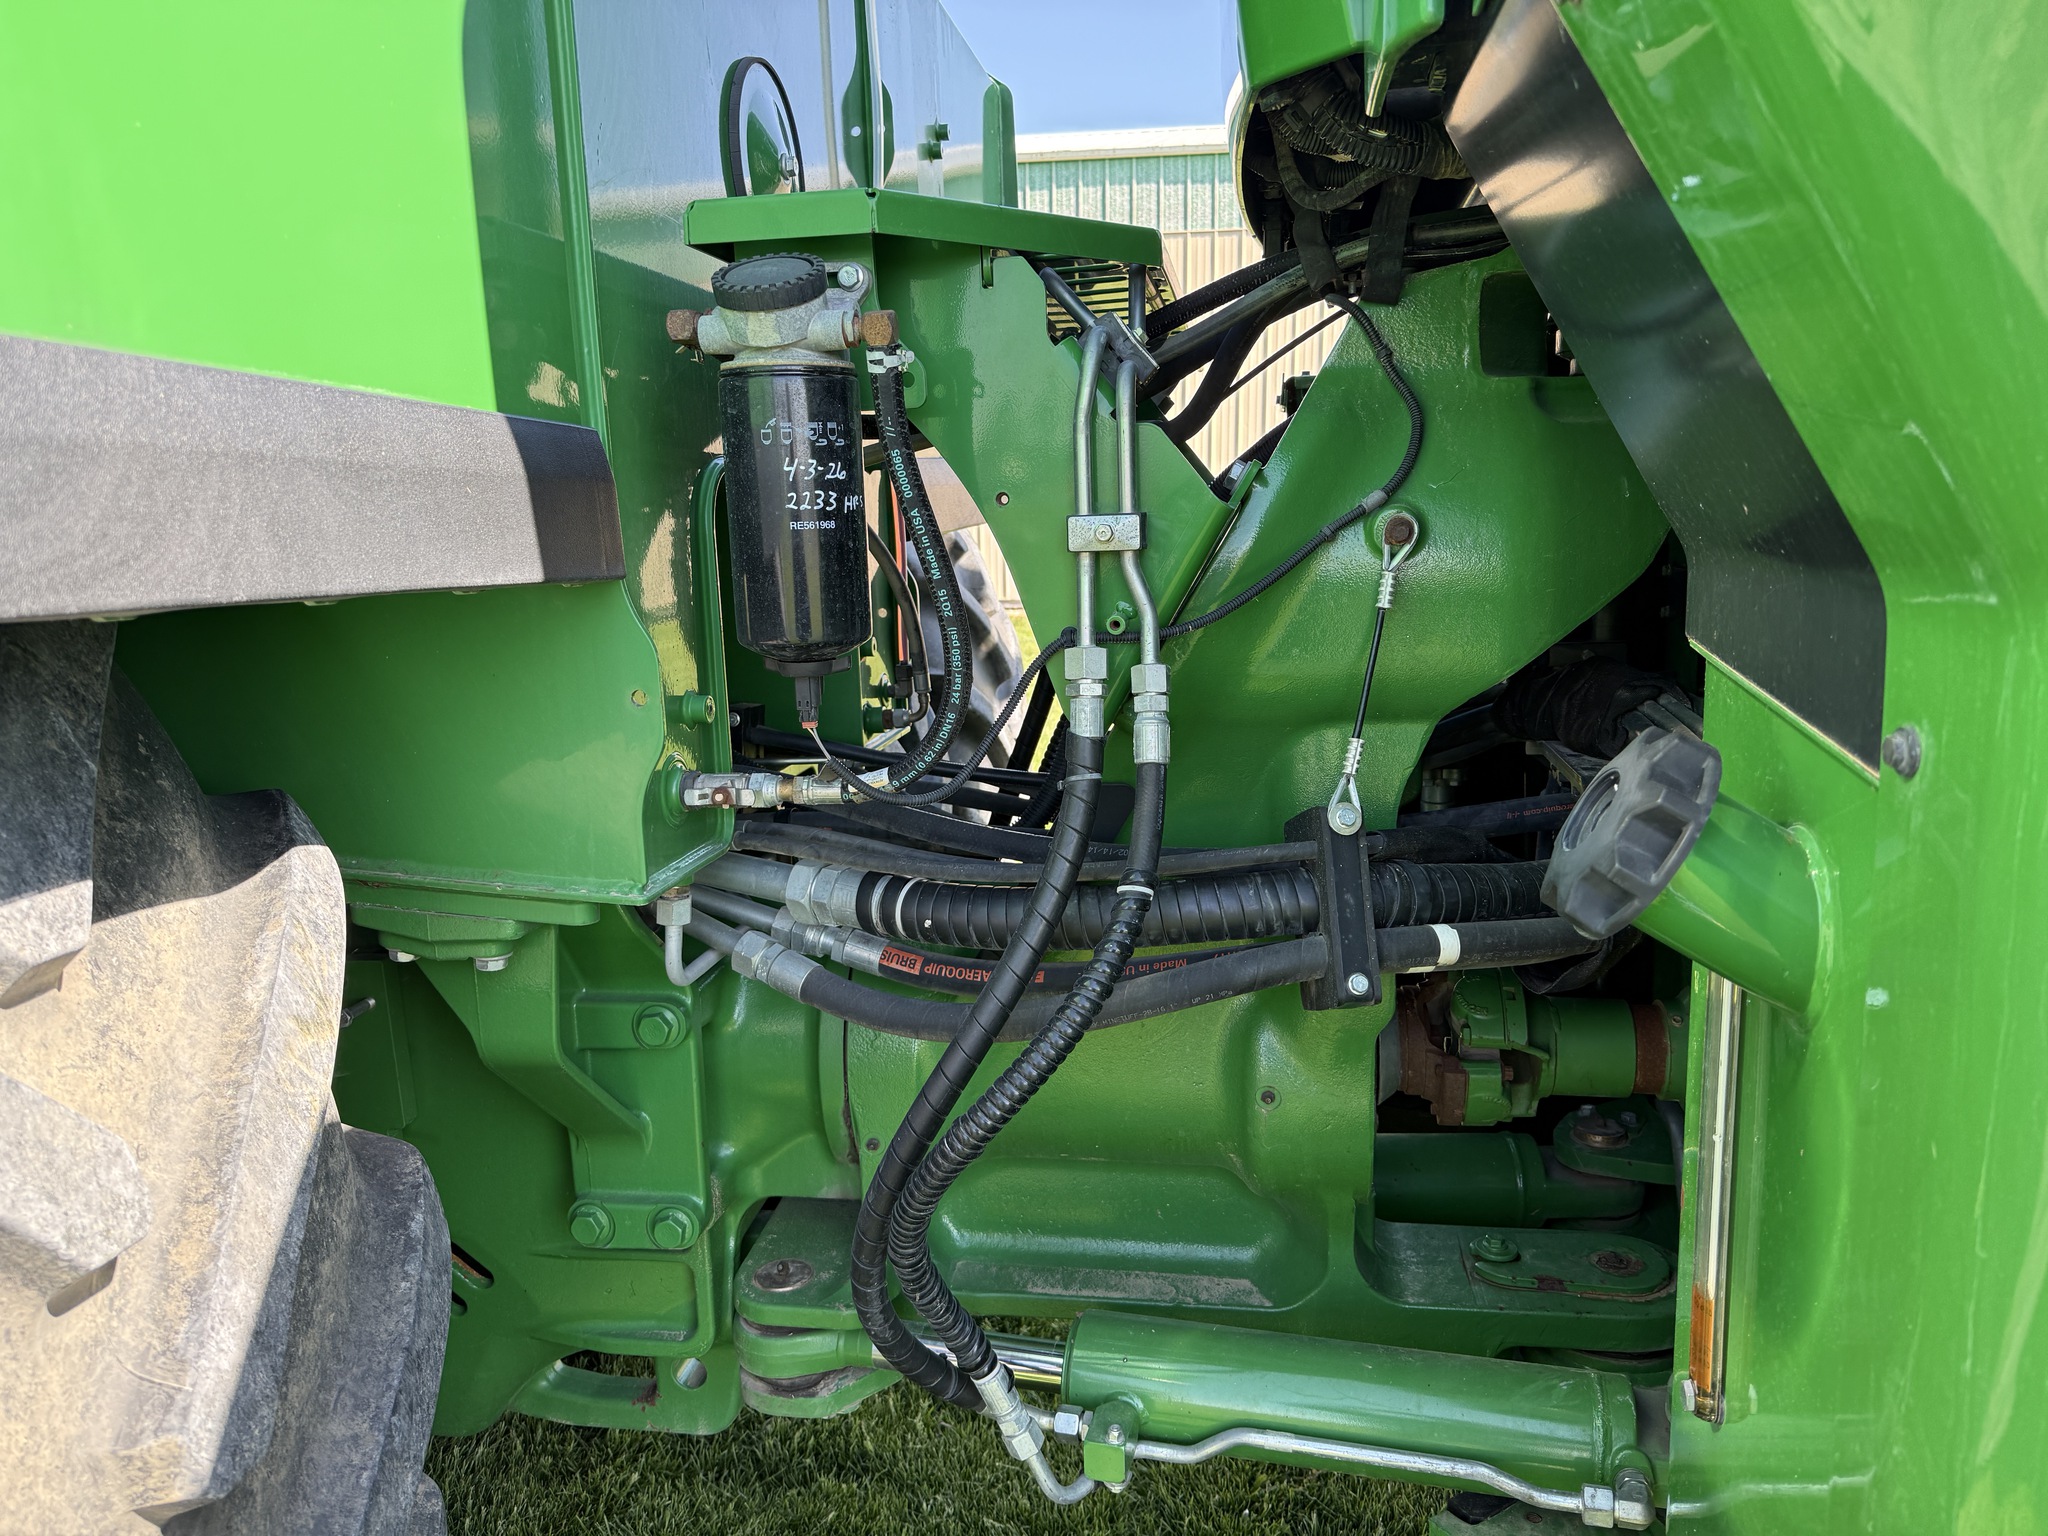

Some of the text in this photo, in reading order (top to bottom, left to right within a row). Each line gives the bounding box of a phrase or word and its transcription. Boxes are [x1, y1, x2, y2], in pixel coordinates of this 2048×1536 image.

[783, 457, 847, 482] 4-3-26
[890, 448, 913, 498] 0000065
[785, 490, 838, 511] 2233
[789, 520, 836, 530] RE561968
[910, 507, 926, 535] USA
[921, 535, 931, 547] in
[925, 548, 942, 580] Made
[937, 589, 953, 618] 2Q15
[947, 627, 961, 648] psi)
[952, 648, 963, 671] (350
[953, 673, 962, 691] bar
[951, 692, 961, 705] 24
[939, 712, 956, 740] DN16
[899, 771, 918, 784] mm
[923, 962, 992, 983] AEROQUIP
[1138, 963, 1150, 974] in
[1153, 958, 1187, 972] Made
[1205, 993, 1214, 1001] 21
